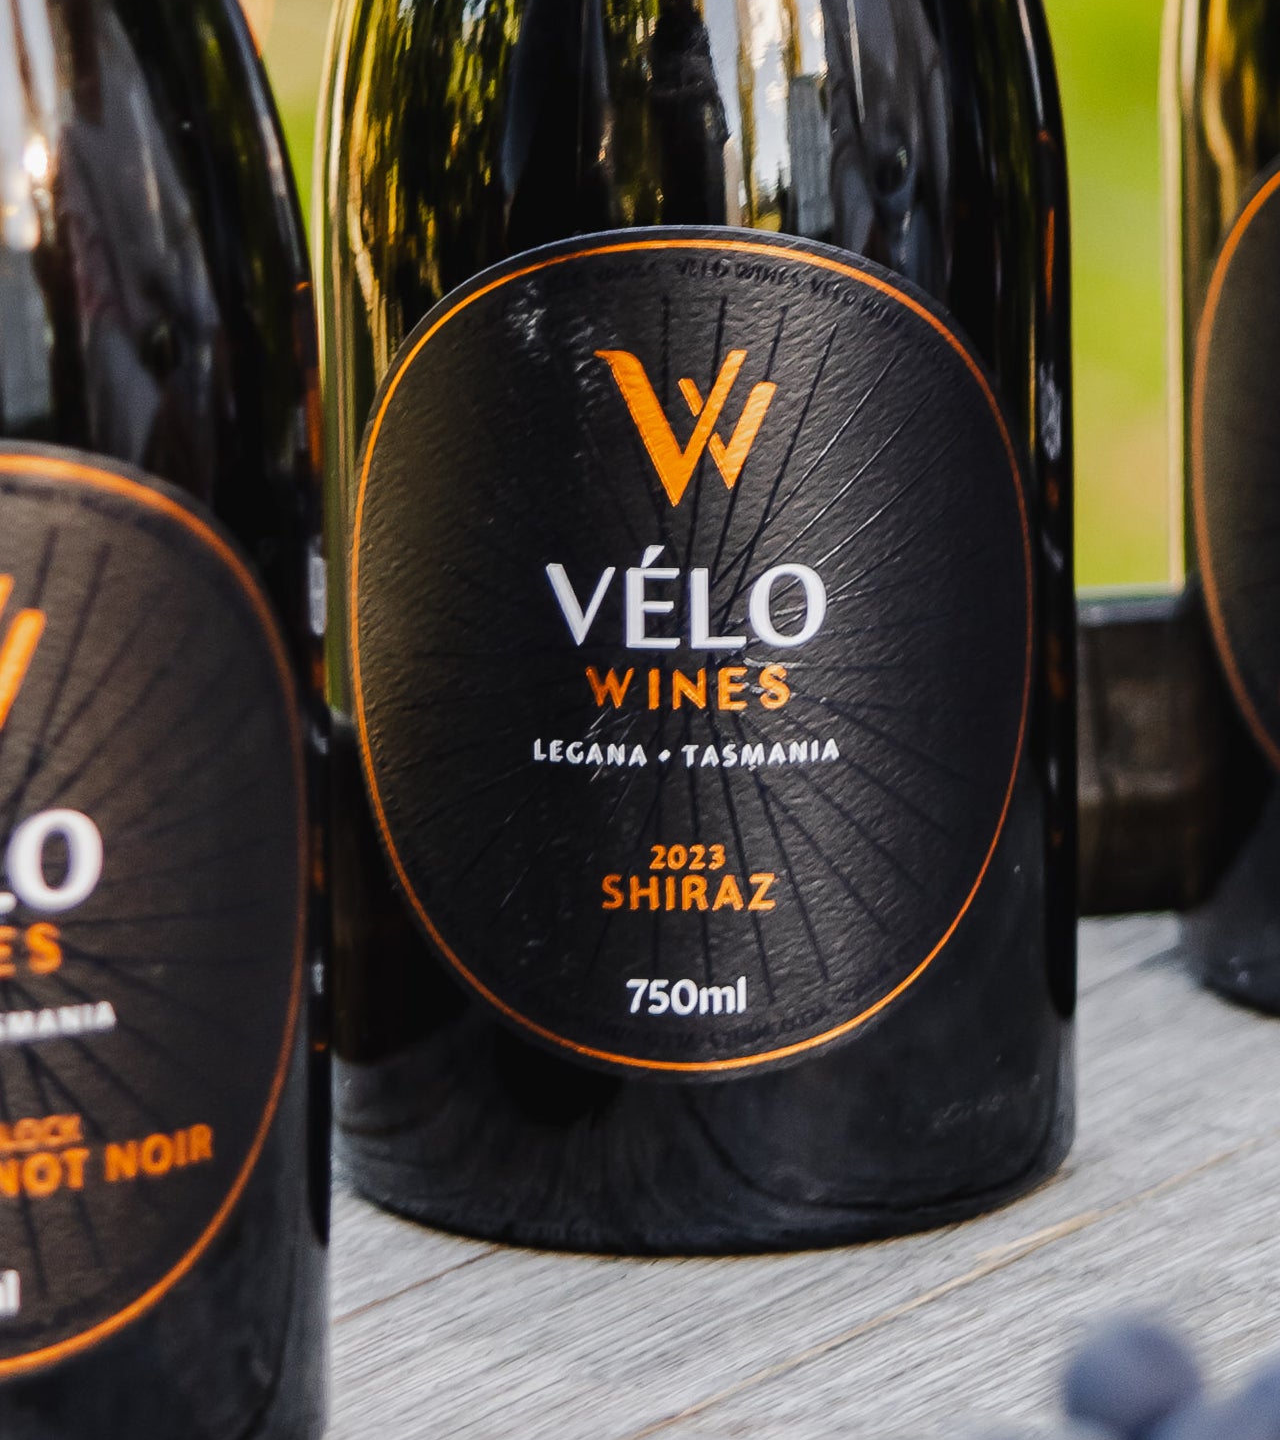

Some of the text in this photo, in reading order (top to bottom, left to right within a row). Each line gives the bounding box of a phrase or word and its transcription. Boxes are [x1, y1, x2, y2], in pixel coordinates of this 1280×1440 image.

[545, 544, 827, 650] VÉLO
[585, 666, 791, 711] WINES
[533, 737, 840, 769] LEGANA TASMANIA
[648, 843, 727, 871] 2023
[601, 873, 777, 912] SHIRAZ
[626, 976, 747, 1016] 750ml
[103, 1123, 214, 1184] NOIR
